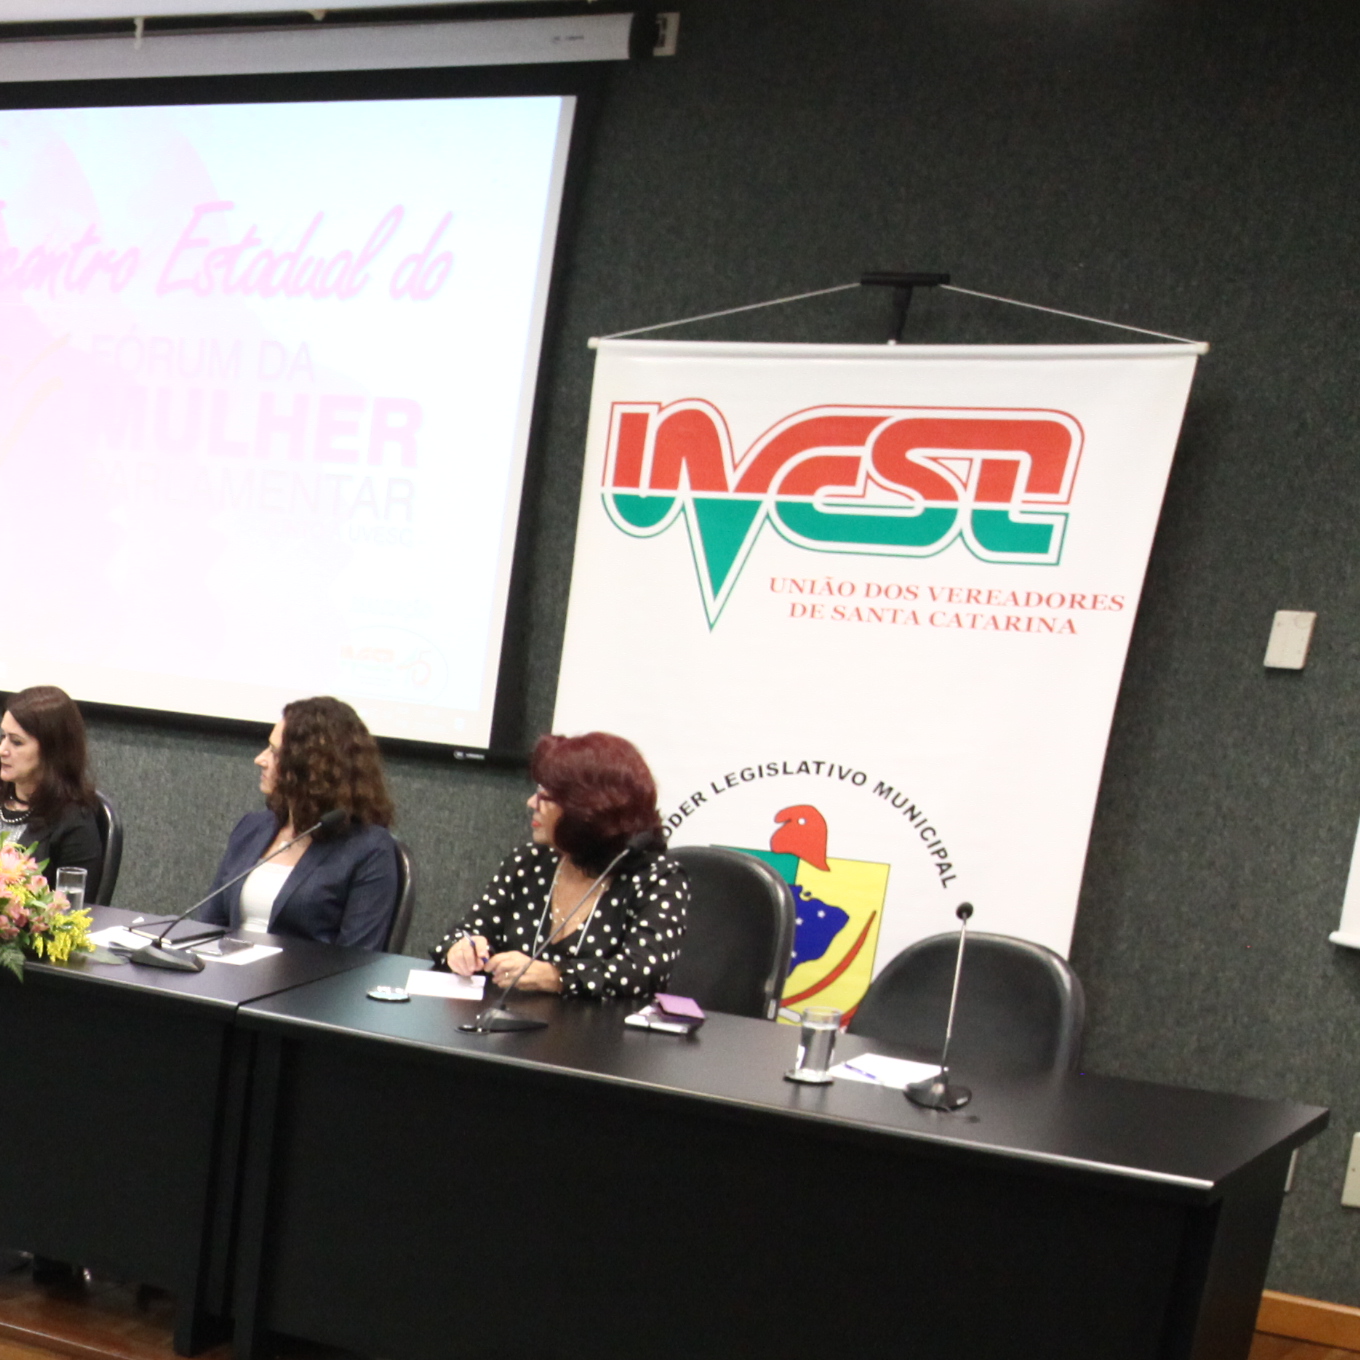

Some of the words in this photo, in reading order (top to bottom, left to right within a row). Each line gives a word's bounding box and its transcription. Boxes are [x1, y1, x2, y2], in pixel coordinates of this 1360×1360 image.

[155, 199, 405, 301] Estadual
[389, 211, 455, 301] do
[89, 325, 242, 381] FÓRUM
[258, 340, 316, 384] DA
[88, 386, 424, 468] MULHER
[81, 459, 416, 522] PARLAMENTAR
[769, 576, 855, 598] UNIÃO
[864, 582, 919, 602] DOS
[928, 585, 1125, 613] VEREADORES
[788, 602, 825, 620] DE
[831, 605, 921, 627] SANTA
[928, 609, 1078, 635] CATARINA
[662, 790, 708, 839] ODER
[710, 760, 868, 795] LEGISLATIVO
[872, 781, 958, 889] MUNICIPAL
